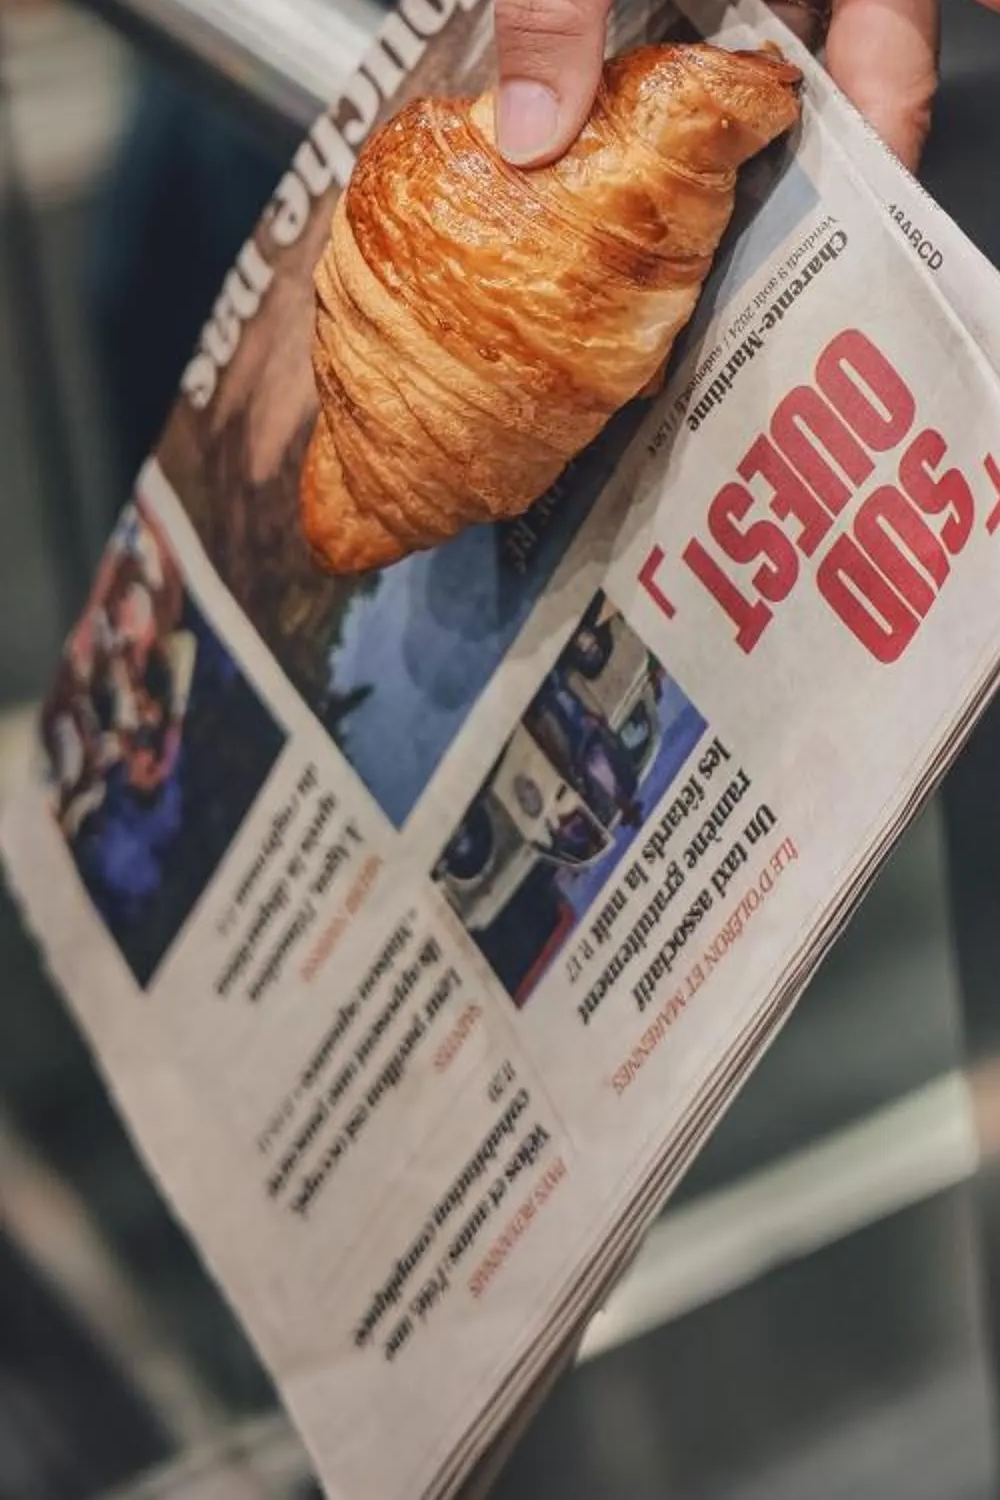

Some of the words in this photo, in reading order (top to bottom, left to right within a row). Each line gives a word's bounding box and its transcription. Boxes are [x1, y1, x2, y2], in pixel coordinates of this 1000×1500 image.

[785, 216, 837, 270] Vendredi
[752, 277, 781, 309] août
[776, 265, 789, 280] 9
[687, 230, 847, 431] Charente-Maritime
[728, 305, 758, 339] 2024
[681, 329, 916, 655] OUEST
[816, 428, 976, 664] SUD
[696, 736, 732, 780] les
[642, 774, 705, 864] fêtards
[683, 768, 751, 869] ramène
[741, 802, 778, 845] Un
[622, 859, 650, 891] la
[710, 842, 748, 898] taxi
[769, 836, 800, 877] ÎLE
[578, 860, 685, 1025] gratuitement
[588, 885, 630, 947] nuit
[632, 889, 713, 1012] associatif
[683, 963, 706, 998] ET
[612, 989, 688, 1096] MARENNES
